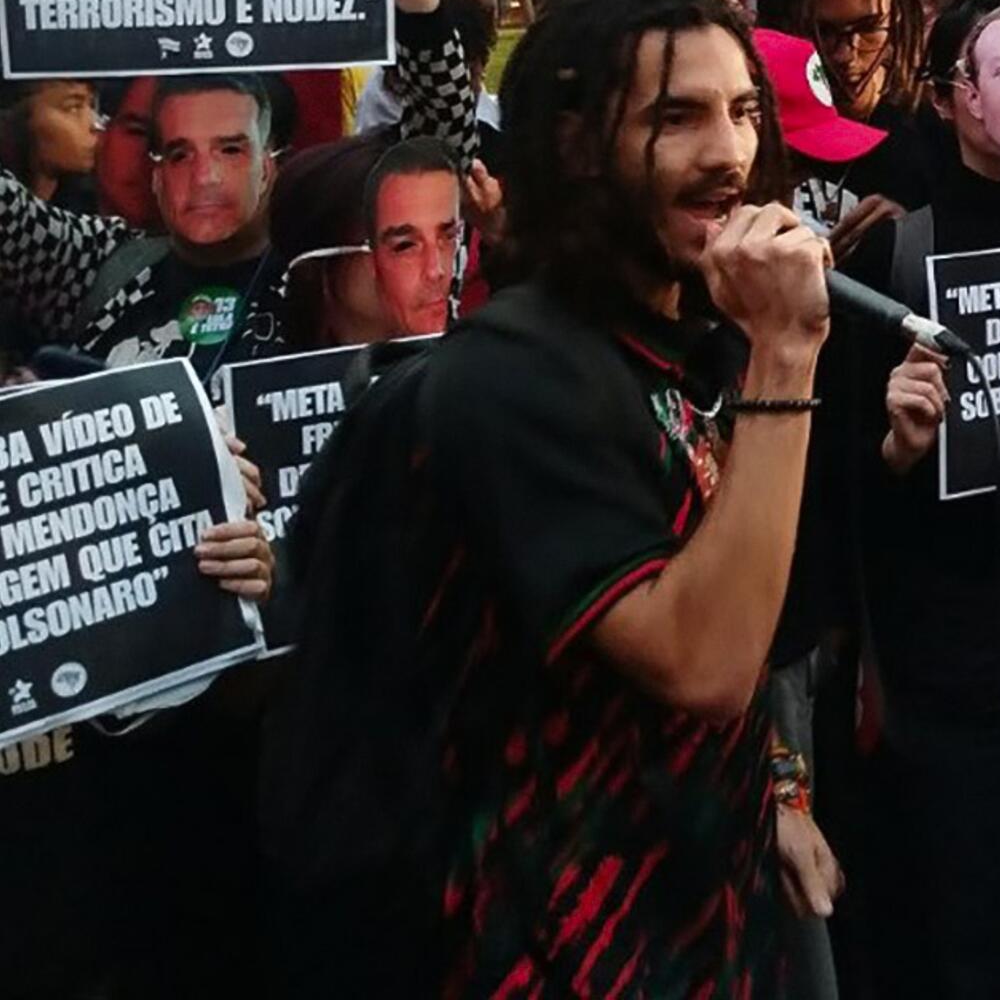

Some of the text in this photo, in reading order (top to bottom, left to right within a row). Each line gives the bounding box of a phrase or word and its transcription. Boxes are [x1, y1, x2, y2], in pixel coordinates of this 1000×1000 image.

[39, 403, 135, 457] VÍDEO
[140, 392, 182, 431] DE
[17, 444, 146, 508] CRITICA
[1, 478, 181, 559] MENDONÇA
[78, 532, 143, 582] QUE
[149, 509, 214, 557] CITA
